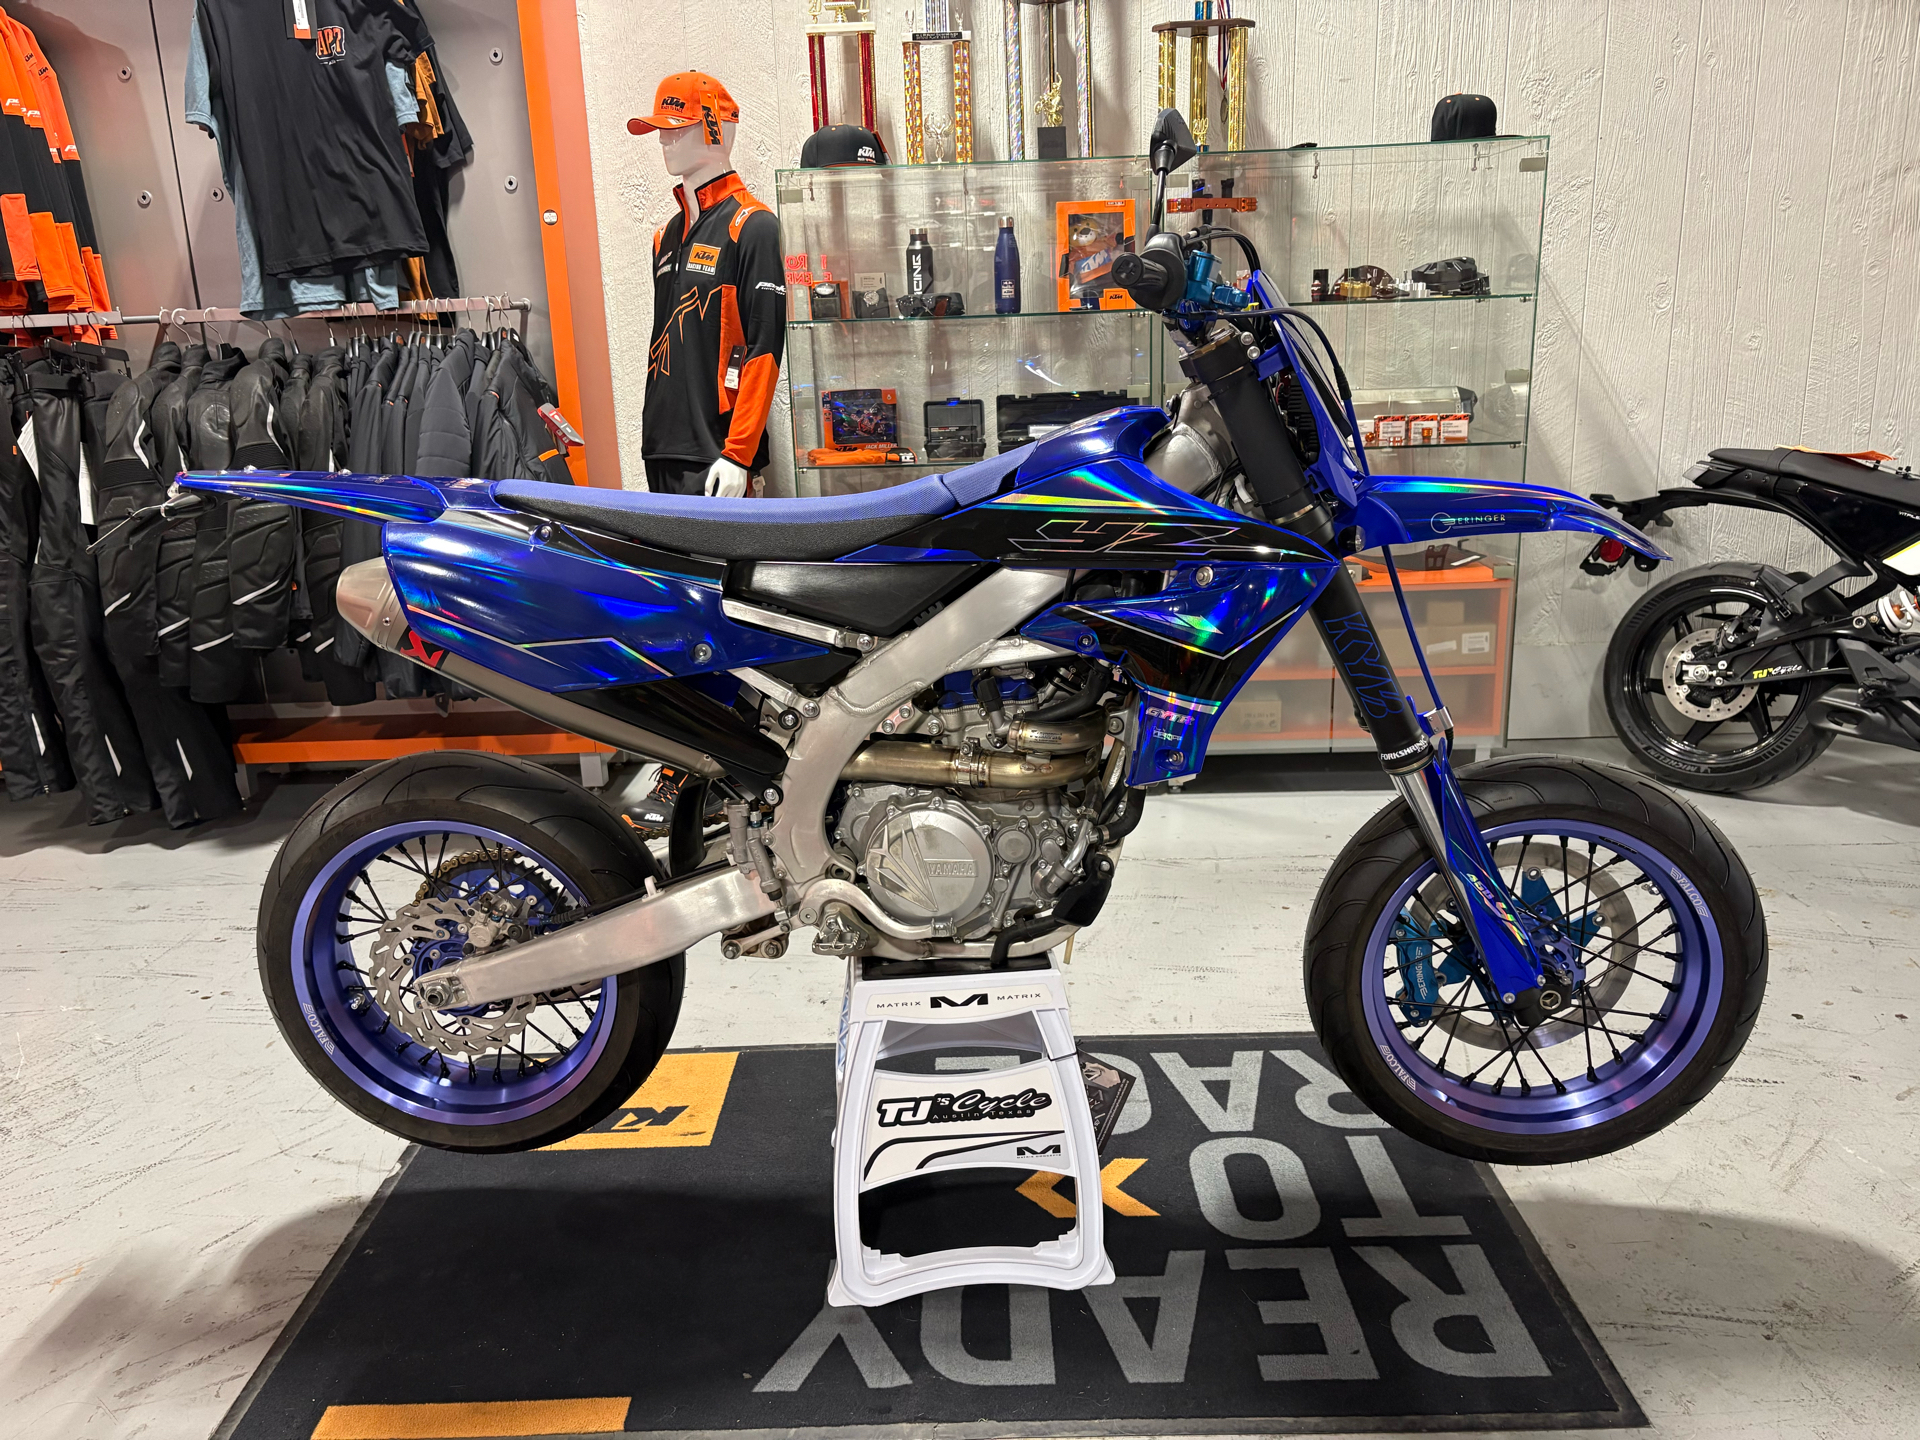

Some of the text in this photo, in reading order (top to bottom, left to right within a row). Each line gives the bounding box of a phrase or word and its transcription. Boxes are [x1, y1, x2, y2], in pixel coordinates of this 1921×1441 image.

[661, 96, 686, 109] KTM
[857, 146, 875, 158] KTM
[693, 250, 715, 262] KTM
[644, 812, 665, 822] KTM
[928, 862, 975, 875] YAMAHA
[876, 1001, 921, 1009] MATRIX
[996, 992, 1042, 1001] MATRIX
[952, 1092, 1047, 1115] Cycle
[932, 1111, 980, 1120] Austin
[1188, 1135, 1472, 1241] TO
